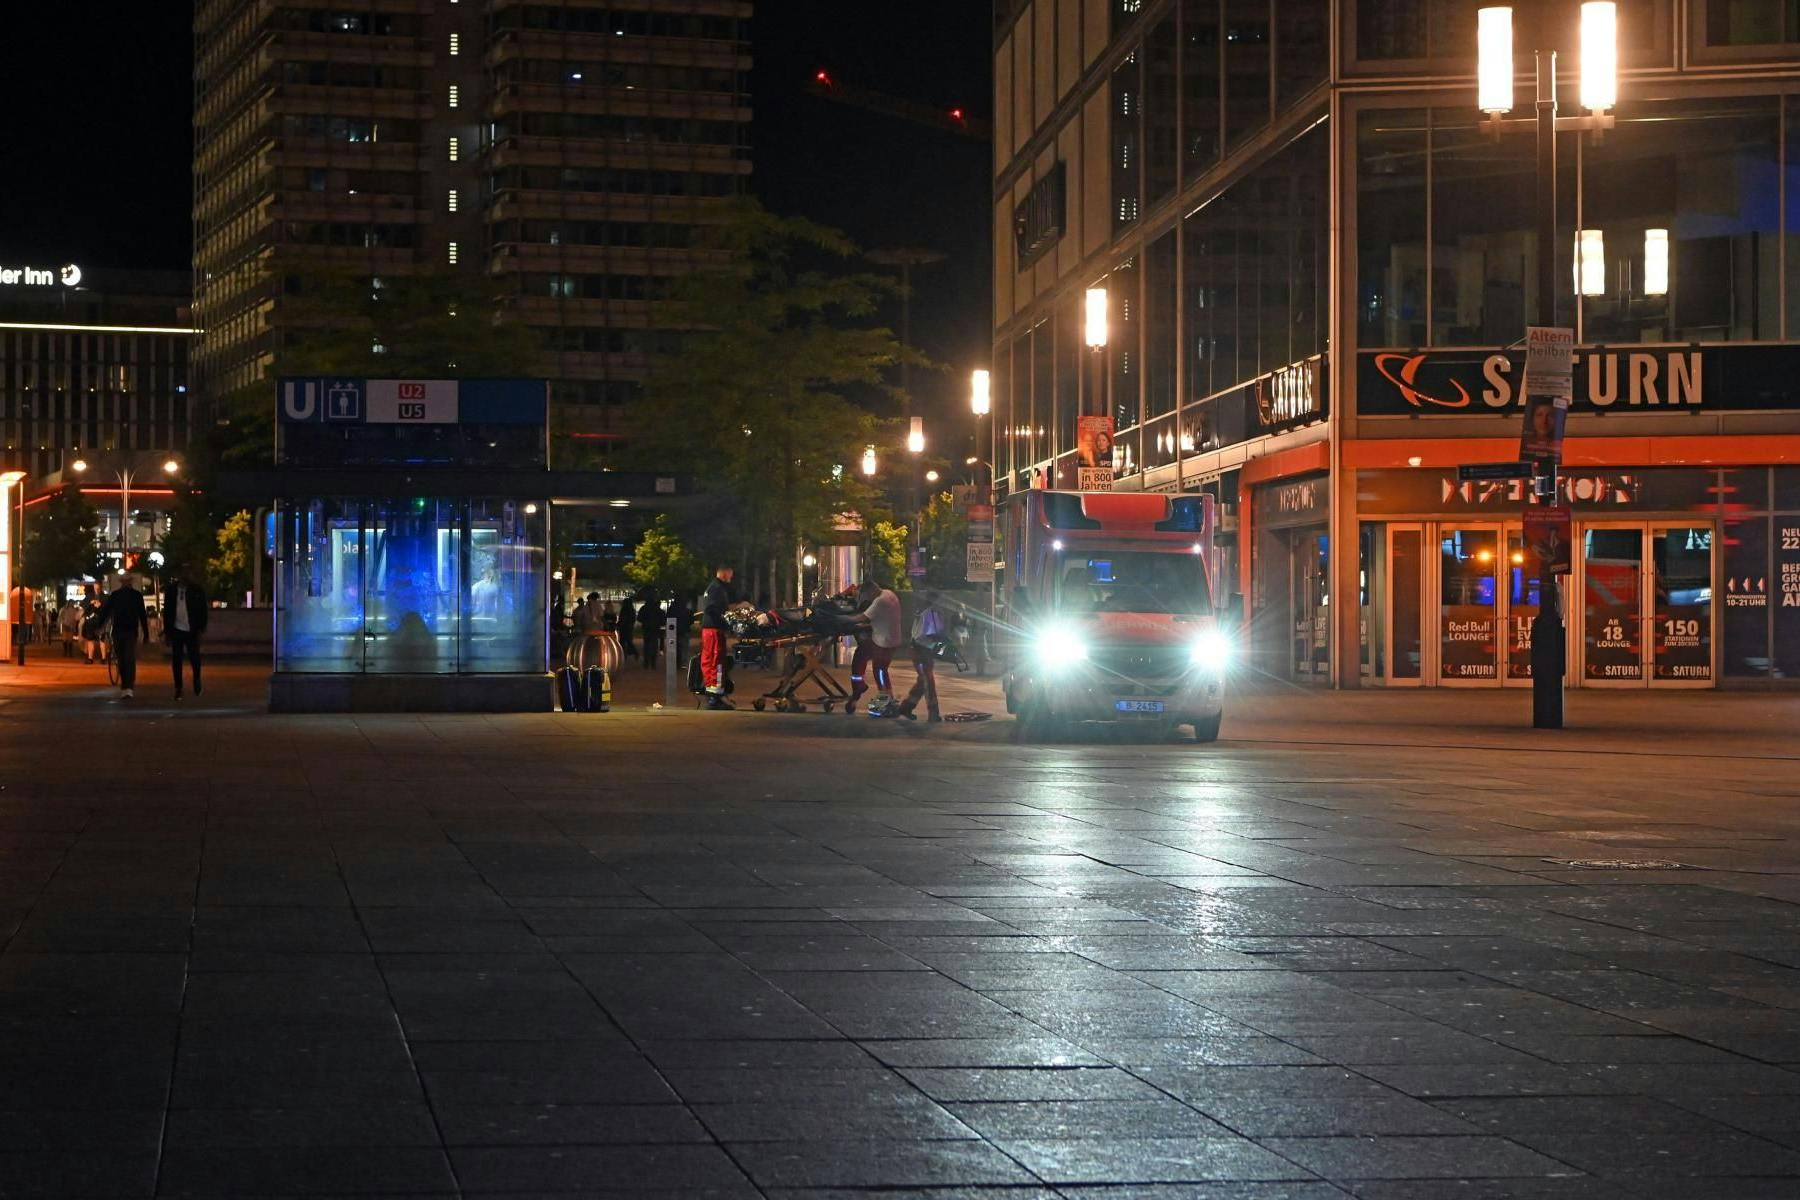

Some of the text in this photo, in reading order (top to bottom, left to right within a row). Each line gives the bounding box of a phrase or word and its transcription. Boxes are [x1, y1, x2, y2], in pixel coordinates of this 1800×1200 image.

[0, 266, 53, 285] er Inn
[1530, 330, 1571, 343] Altern
[1483, 352, 1702, 407] SURN
[401, 386, 423, 398] U2
[285, 382, 315, 420] U
[401, 405, 423, 417] U5
[1082, 473, 1111, 481] in 800
[1081, 482, 1112, 491] Jahren
[1782, 573, 1800, 583] GR
[1782, 583, 1800, 593] GA
[1449, 621, 1490, 632] Red Bull
[1665, 620, 1698, 635] 150
[1449, 632, 1490, 641] LOUNGE
[1603, 627, 1623, 640] 18
[1597, 640, 1631, 648] LOUNGE
[1461, 664, 1495, 676] SATURN
[1605, 665, 1640, 676] SATURN
[1672, 665, 1710, 676] SATURN
[1136, 701, 1158, 711] 2415
